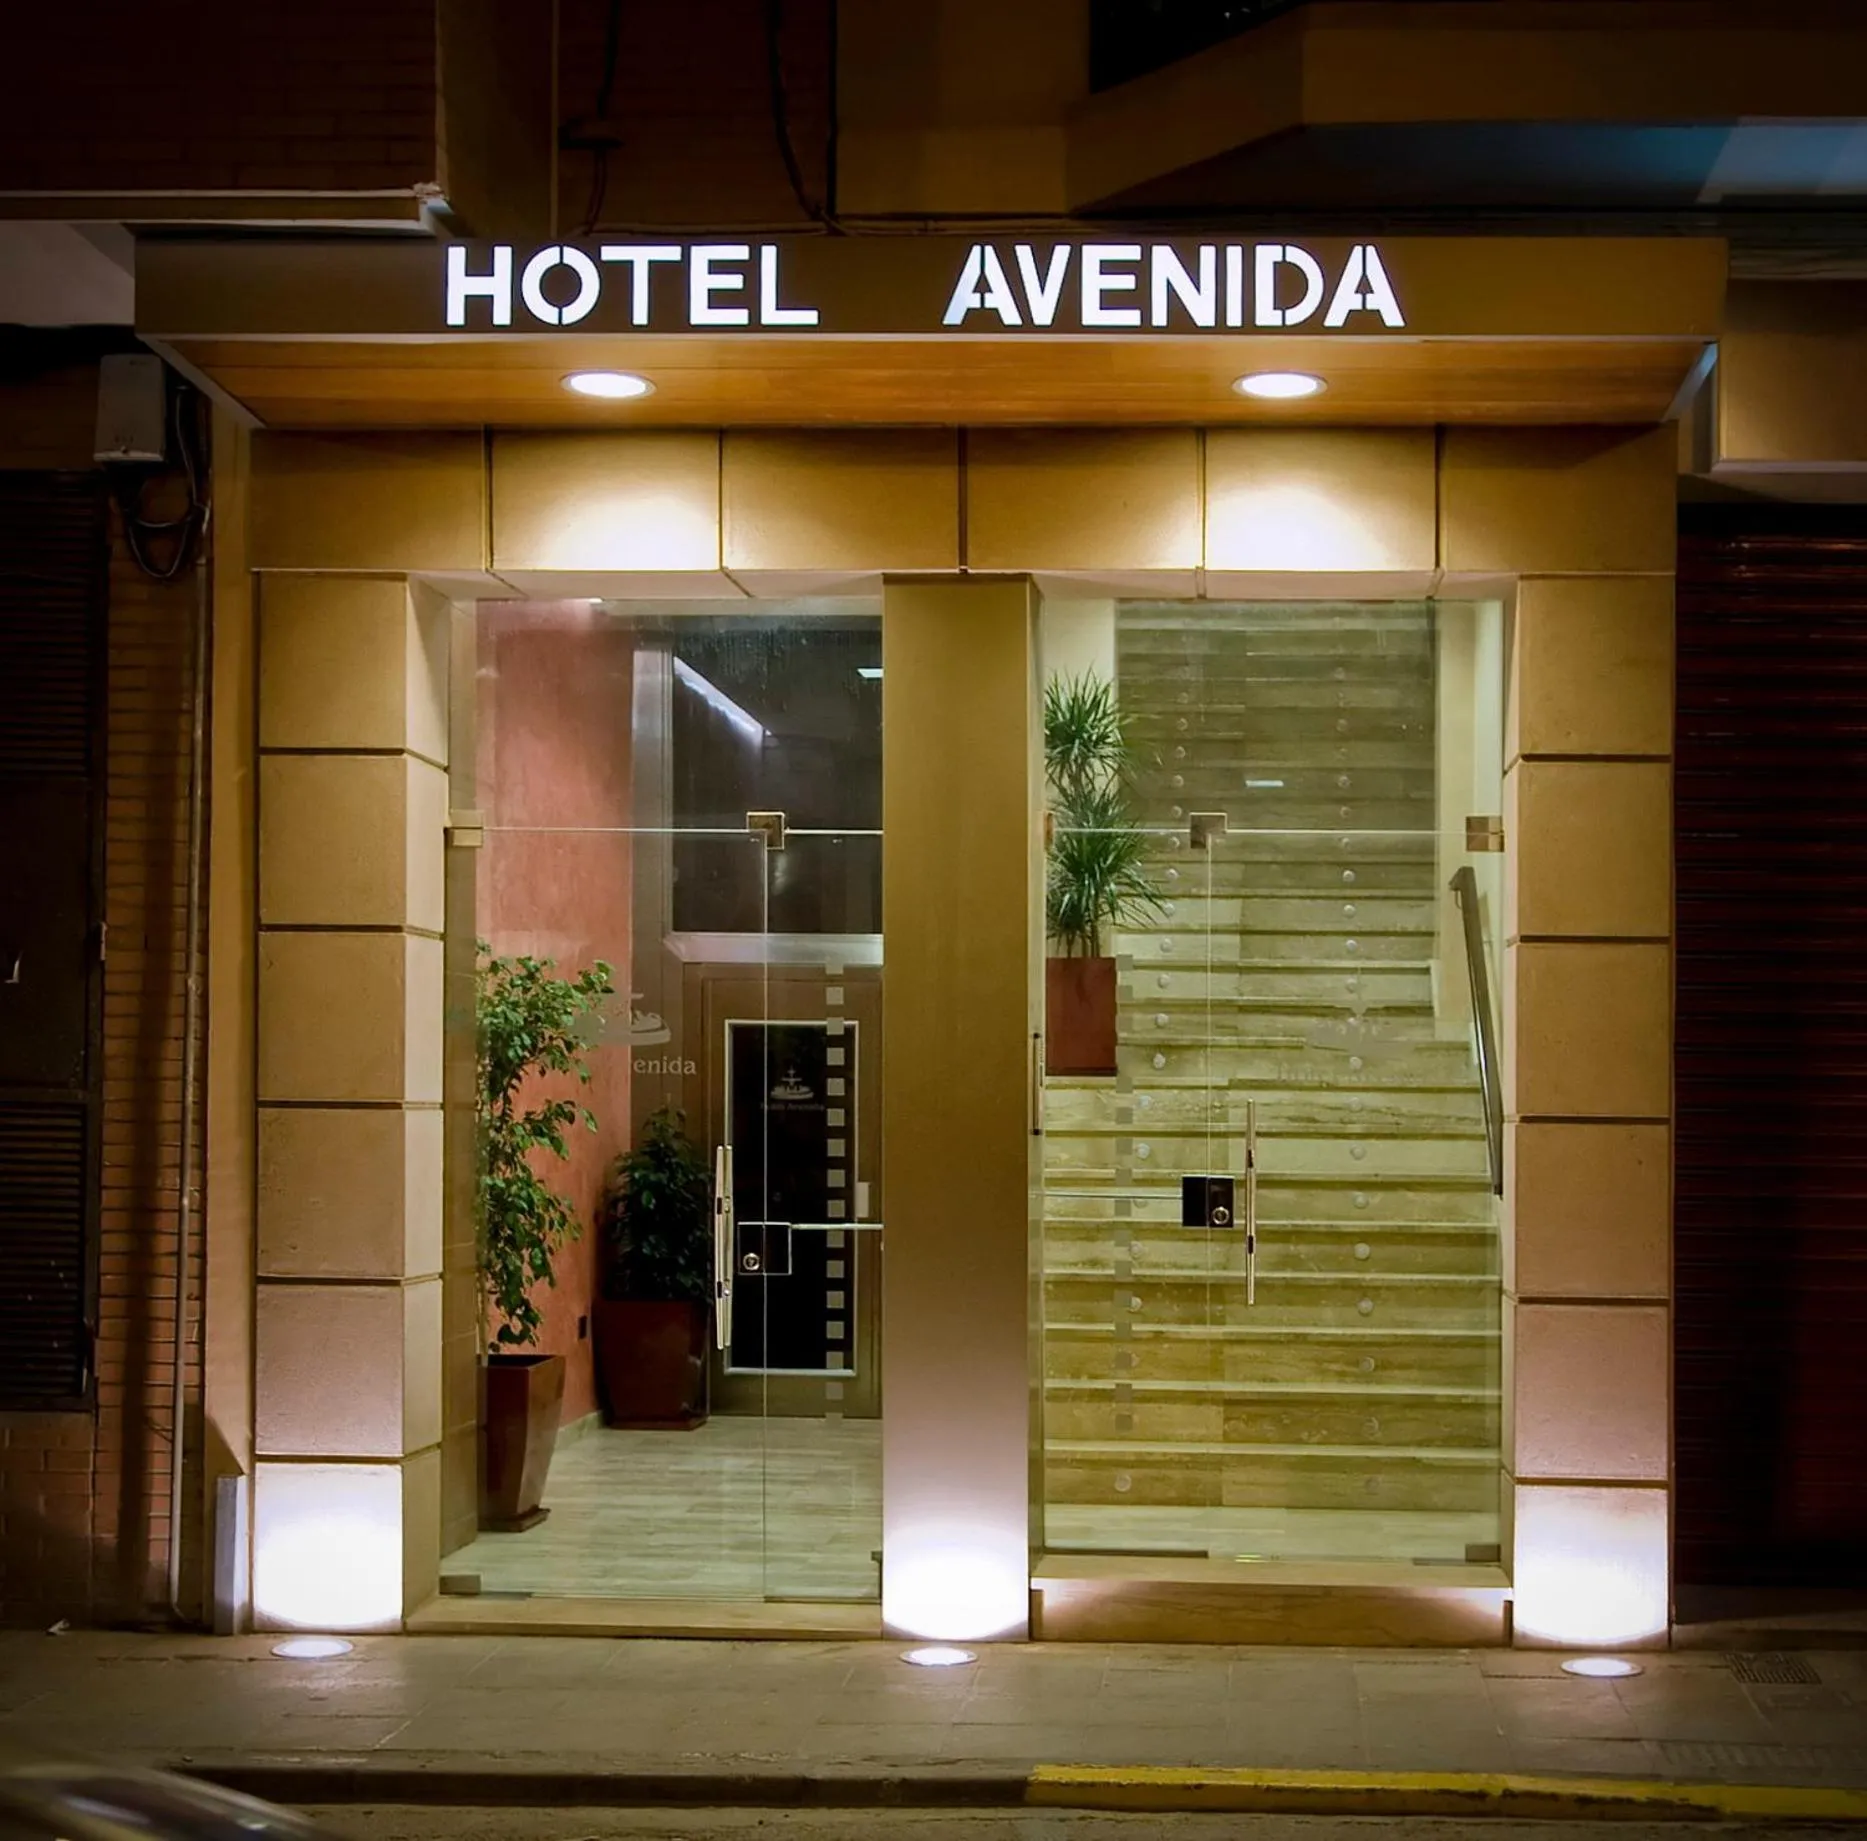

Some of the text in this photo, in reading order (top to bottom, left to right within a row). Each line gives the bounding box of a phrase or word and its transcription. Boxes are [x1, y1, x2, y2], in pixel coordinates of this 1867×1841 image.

[446, 244, 1406, 328] HOTEL AVENIDA
[631, 1056, 697, 1075] enida
